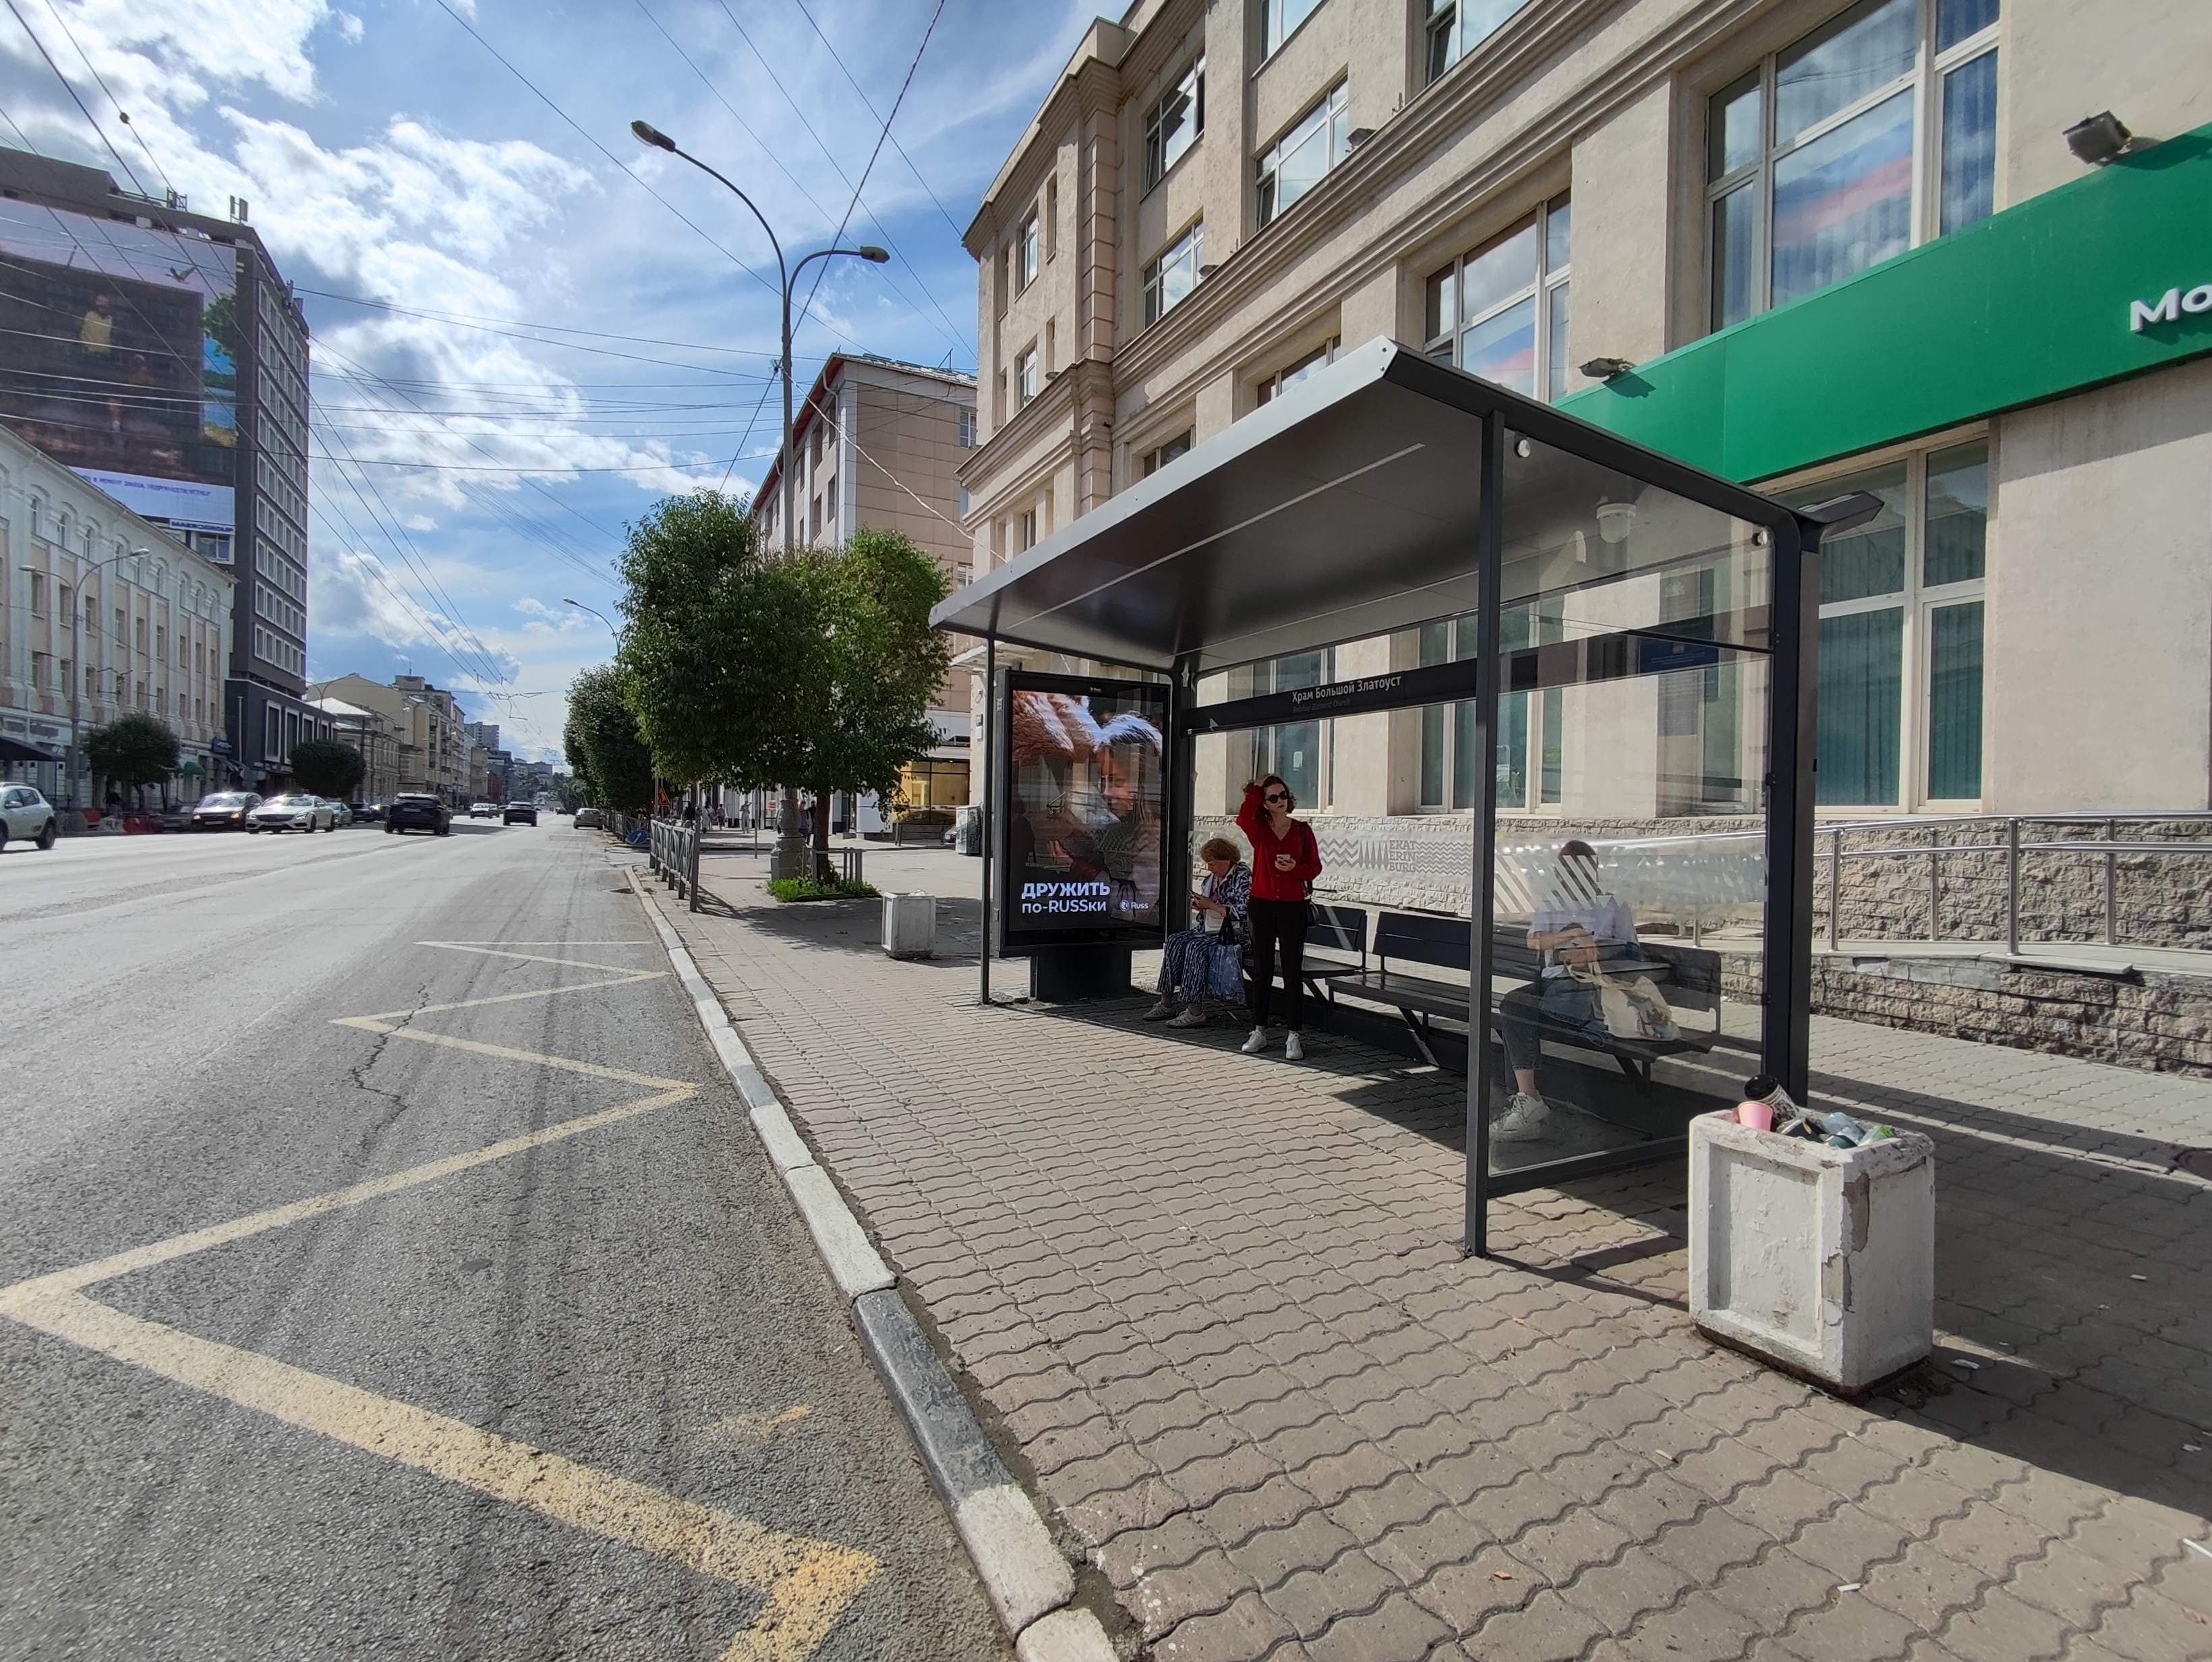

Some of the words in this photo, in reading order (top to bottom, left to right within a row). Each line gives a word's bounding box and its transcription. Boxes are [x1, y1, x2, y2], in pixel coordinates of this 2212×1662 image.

[1292, 691, 1314, 704] Храм
[1316, 683, 1355, 699] Большой
[1357, 676, 1401, 692] Златоуст
[1389, 840, 1416, 850] EKAT
[1389, 851, 1416, 861] ERIN
[1389, 862, 1416, 872] BURG
[1021, 882, 1110, 899] ДРУЖИТЬ
[1022, 899, 1106, 913] по-RUSSки
